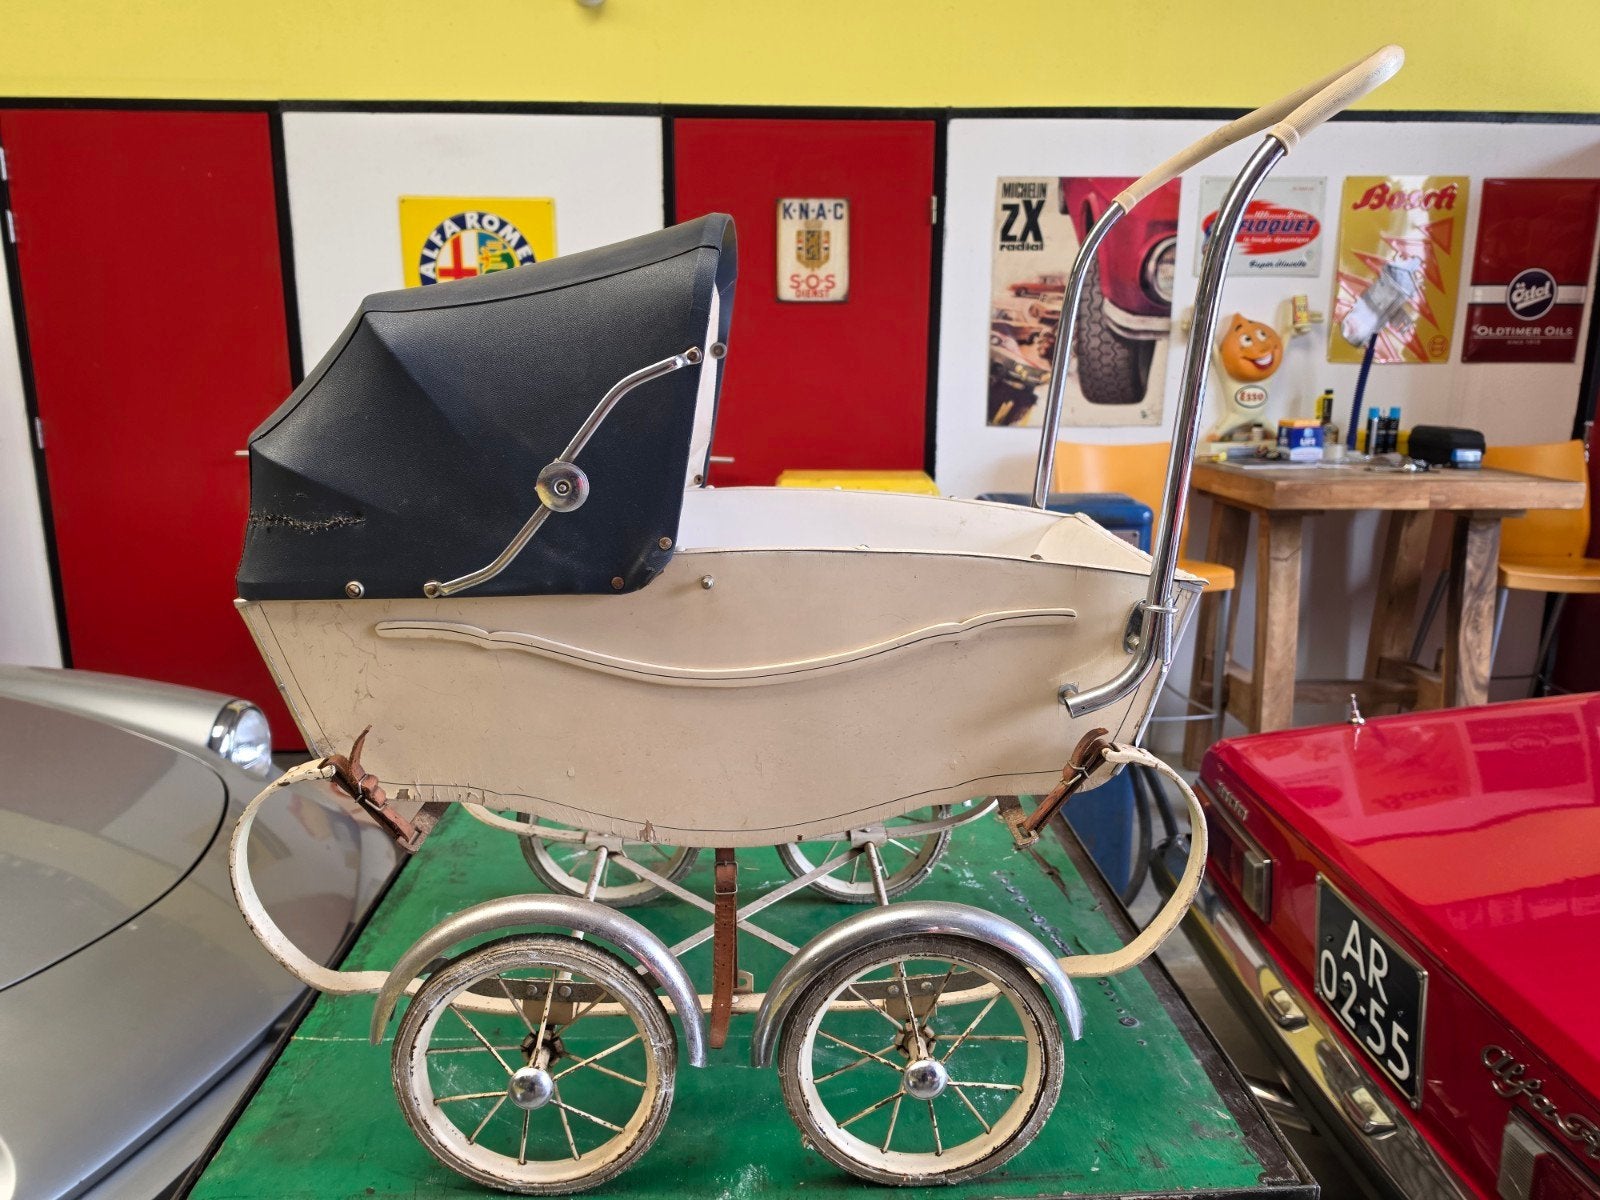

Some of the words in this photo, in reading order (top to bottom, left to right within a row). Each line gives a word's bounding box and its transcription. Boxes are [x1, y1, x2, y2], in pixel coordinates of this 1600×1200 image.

[1002, 183, 1047, 198] MICHELIN
[1001, 200, 1045, 242] ZX
[420, 219, 461, 280] ALFA
[464, 211, 535, 266] ROME
[1000, 243, 1044, 251] radial
[1544, 325, 1573, 336] OILS
[1239, 391, 1265, 401] Esso
[1341, 919, 1388, 1005] AR
